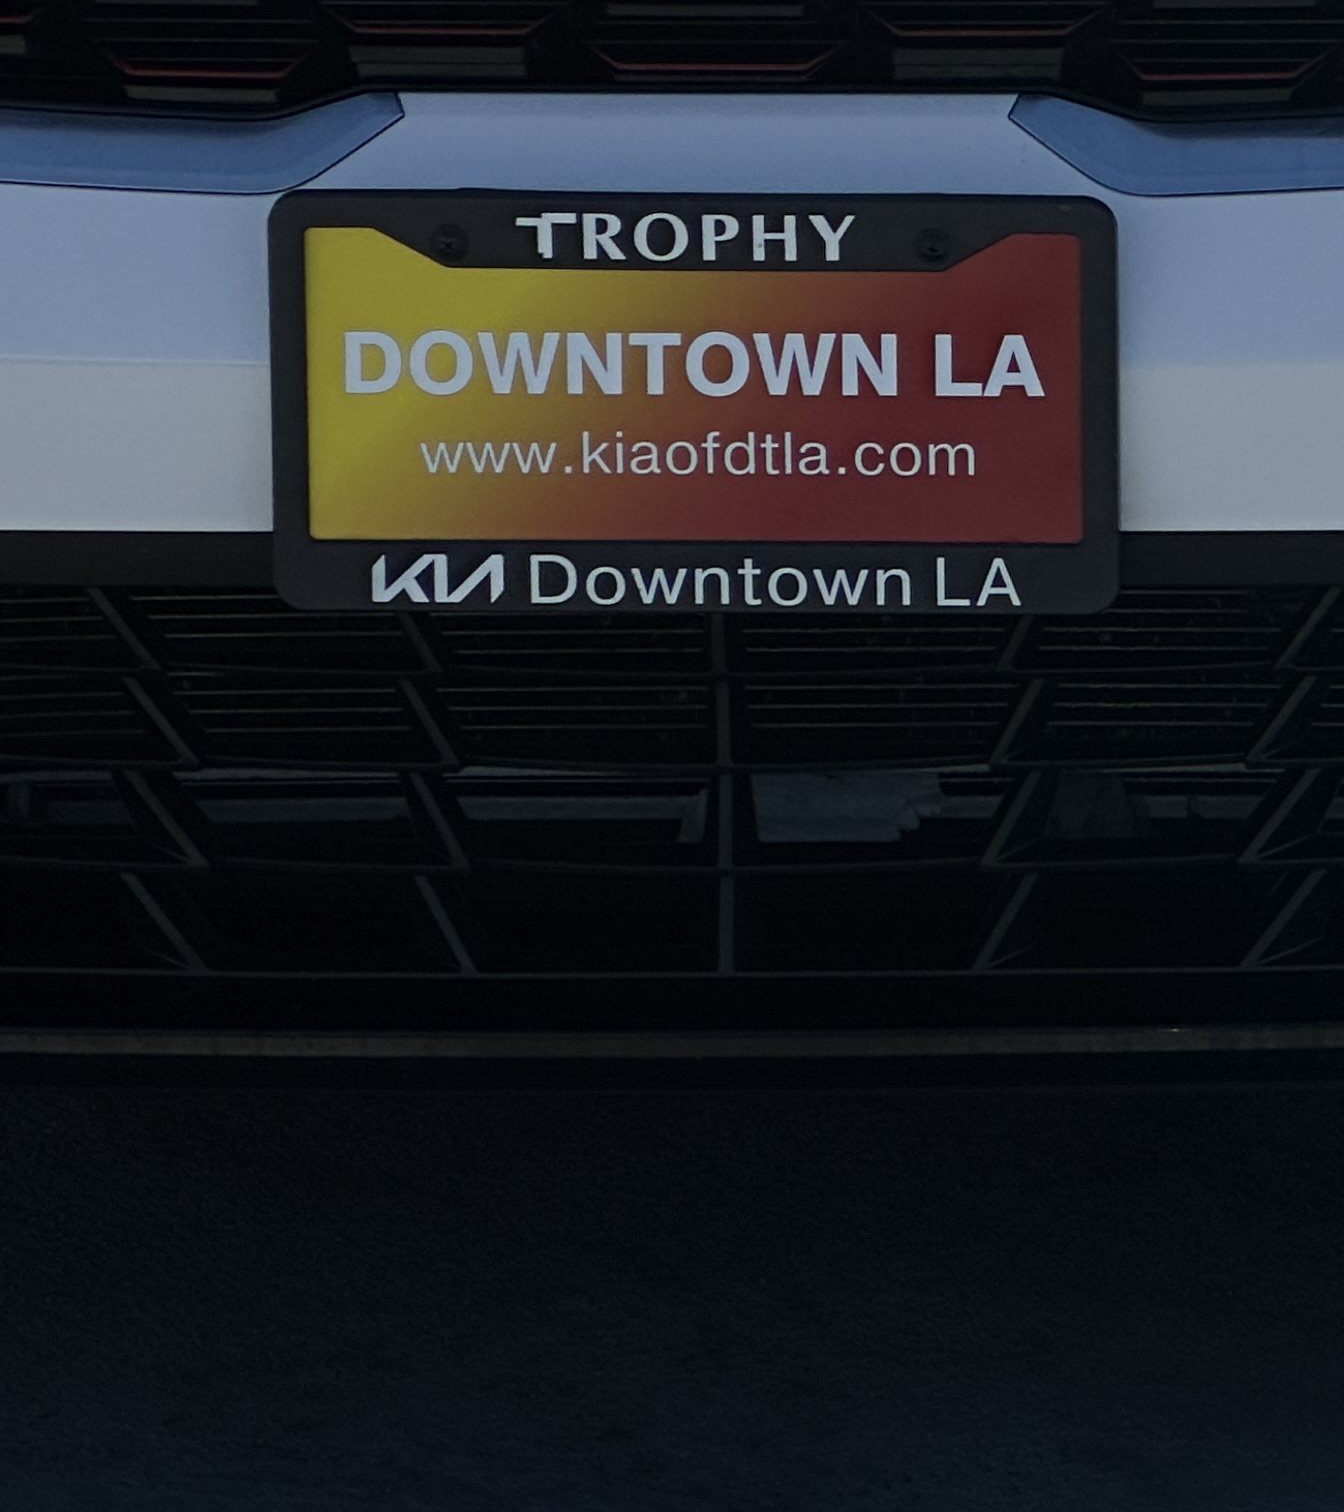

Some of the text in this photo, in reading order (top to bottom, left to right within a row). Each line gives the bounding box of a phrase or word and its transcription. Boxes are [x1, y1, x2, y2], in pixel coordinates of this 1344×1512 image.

[516, 212, 857, 262] TROPHY
[344, 330, 1045, 397] DOWNTOWN LA
[421, 431, 976, 476] www.kiaofdtla.com
[530, 554, 911, 607] Downtown
[936, 558, 1022, 607] LA
